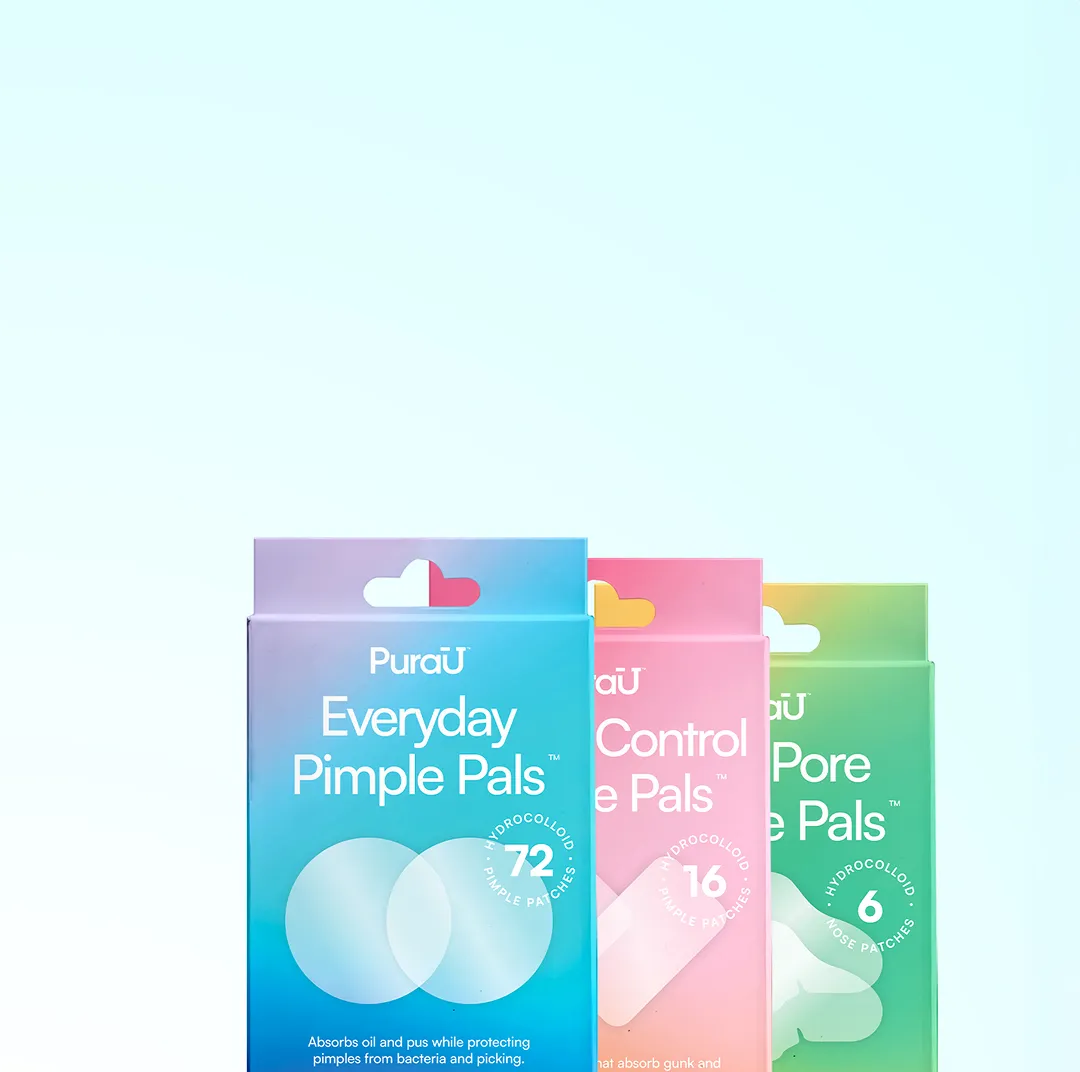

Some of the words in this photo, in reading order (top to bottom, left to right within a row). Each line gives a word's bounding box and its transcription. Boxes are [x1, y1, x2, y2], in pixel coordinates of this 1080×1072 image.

[323, 695, 517, 748] Everyday
[596, 717, 747, 757] Control
[295, 754, 444, 806] Pimple
[773, 741, 871, 783] Pore
[484, 812, 574, 850] HYDROCOLLOID
[504, 843, 554, 877] 72
[660, 833, 749, 871] HYDROCOLLOID
[483, 867, 521, 906] PIMPLE
[527, 866, 576, 907] PATCHES
[683, 864, 727, 898] 16
[825, 858, 915, 897] HYDROCOLLOID
[857, 890, 883, 923] 6
[826, 918, 857, 950] NOSE
[860, 918, 915, 954] PATCHES
[307, 1035, 359, 1048] Absorbs
[361, 1035, 376, 1048] oil
[379, 1035, 403, 1048] and
[406, 1038, 429, 1051] pus
[431, 1035, 465, 1048] while
[467, 1035, 531, 1051] protecting
[313, 1052, 362, 1067] pimples
[364, 1052, 394, 1065] from
[396, 1052, 447, 1065] bacteria
[449, 1052, 474, 1065] and
[476, 1052, 525, 1068] picking.
[617, 1056, 661, 1069] absorb
[663, 1056, 695, 1072] gunk
[697, 1056, 721, 1069] and
